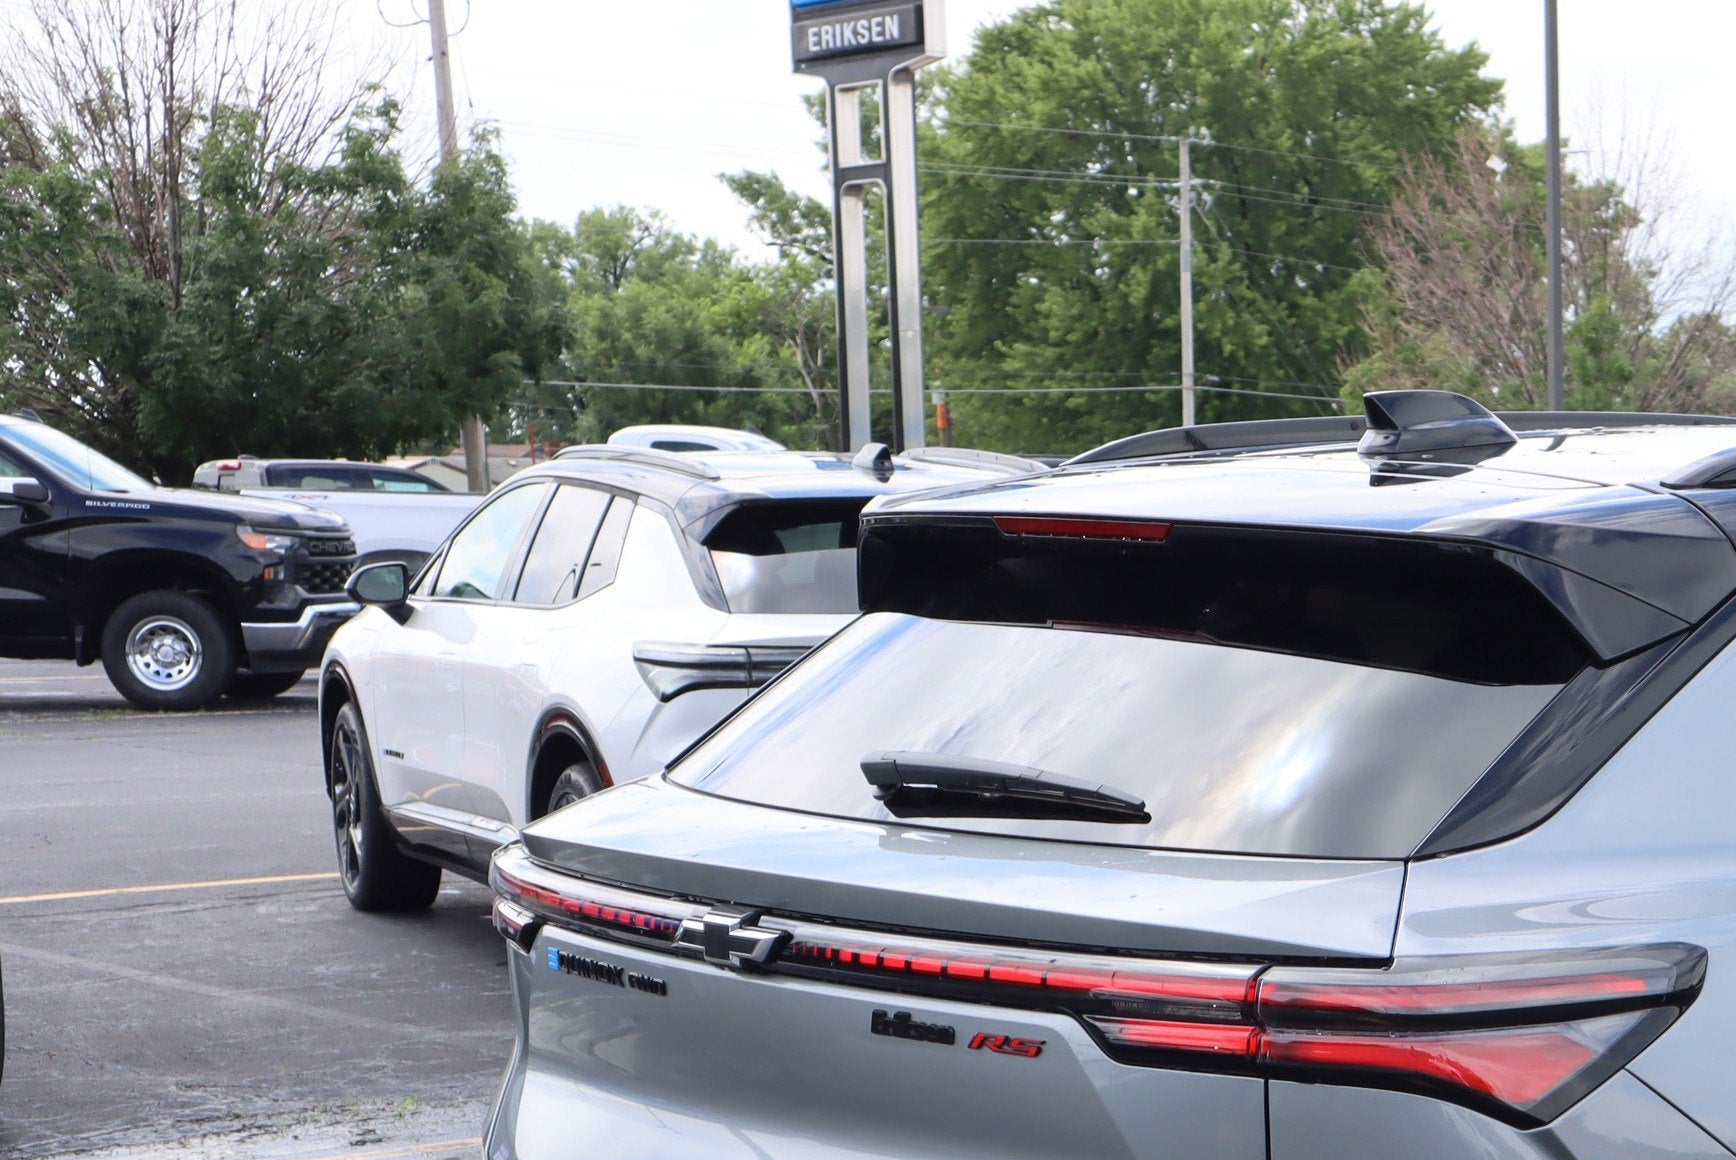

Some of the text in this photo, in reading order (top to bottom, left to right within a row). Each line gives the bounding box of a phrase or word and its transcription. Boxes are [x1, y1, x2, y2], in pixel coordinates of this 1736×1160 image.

[808, 14, 899, 51] ERIKSEN
[85, 500, 150, 510] SILVERADO
[547, 946, 626, 988] EQUINOX
[967, 1032, 1047, 1058] RS
